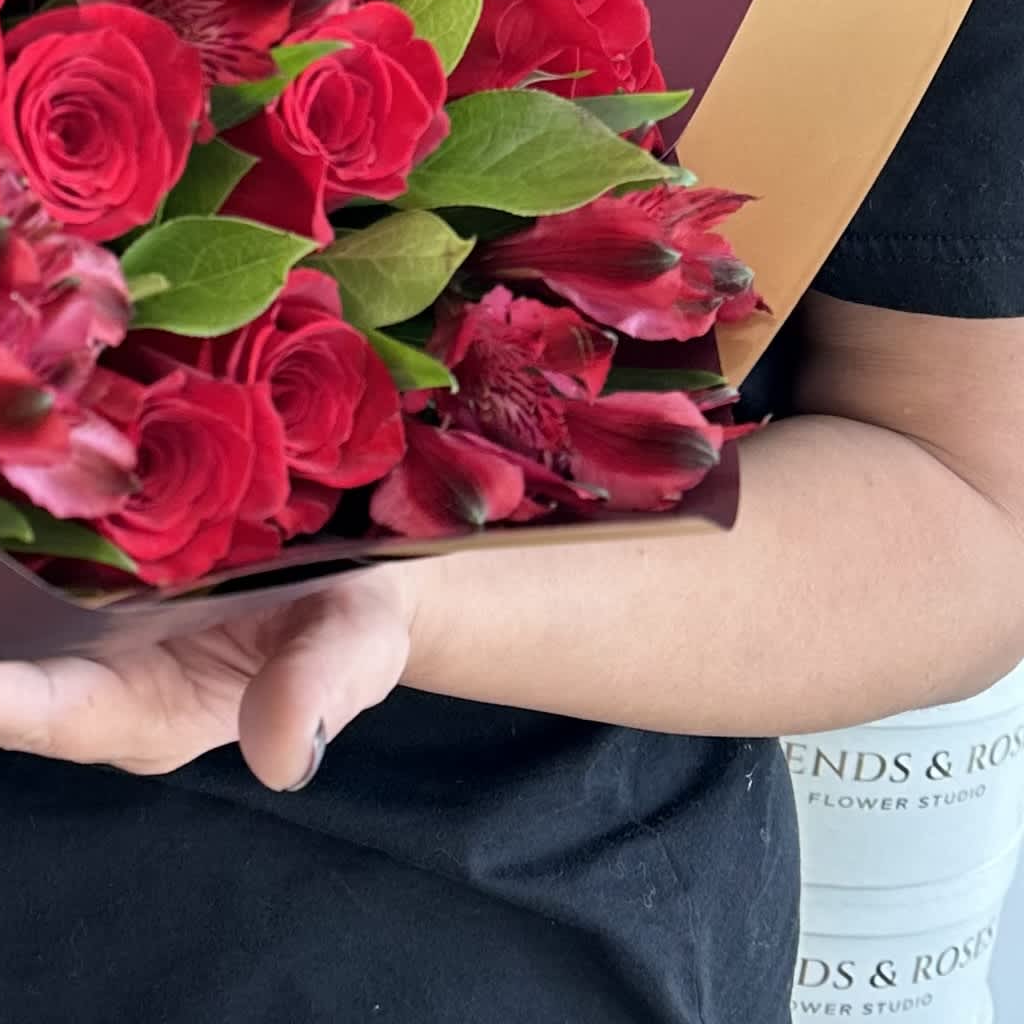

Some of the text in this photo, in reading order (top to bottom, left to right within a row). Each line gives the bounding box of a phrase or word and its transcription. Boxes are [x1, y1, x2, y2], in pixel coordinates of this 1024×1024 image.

[925, 750, 953, 781] &
[807, 784, 987, 811] FLOWER STUDIO
[869, 959, 897, 990] &
[862, 993, 933, 1017] STUDIO
